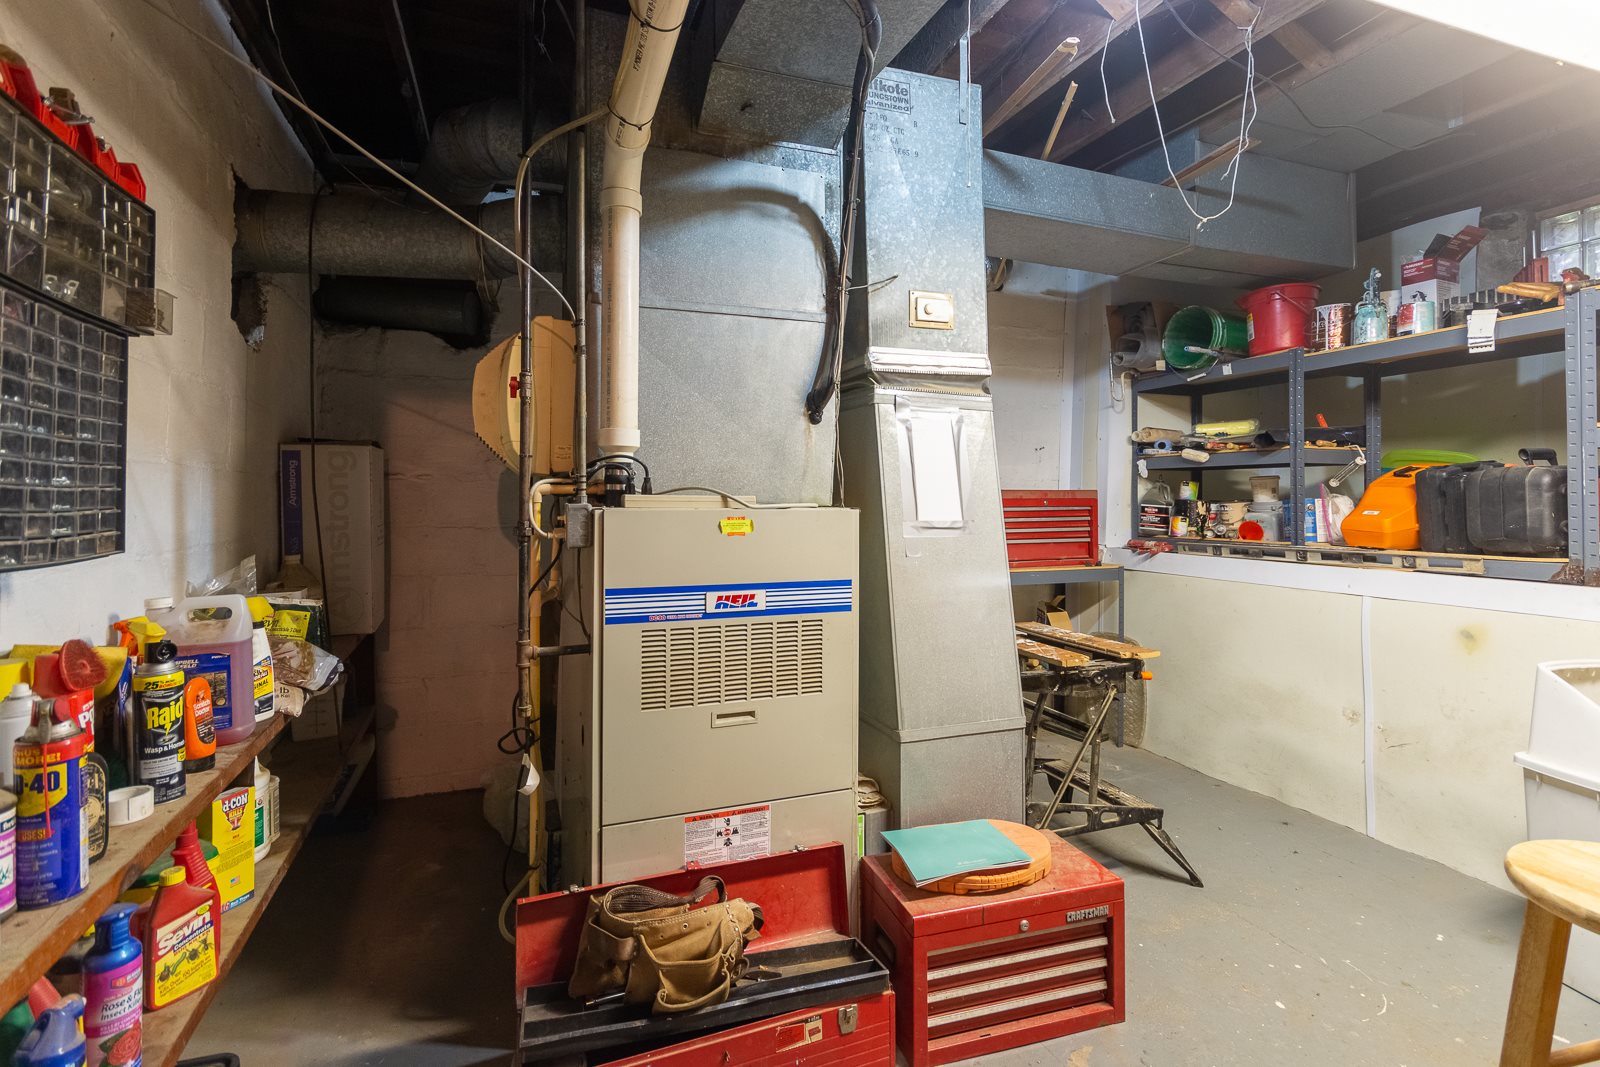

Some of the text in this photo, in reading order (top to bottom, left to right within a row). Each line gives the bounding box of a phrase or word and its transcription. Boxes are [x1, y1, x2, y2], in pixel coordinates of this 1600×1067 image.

[288, 460, 298, 506] Armstrong
[714, 593, 759, 610] HEIL
[147, 696, 184, 730] Raid
[144, 746, 163, 754] Wasp
[223, 793, 249, 812] d-CON
[1066, 905, 1109, 923] CRAFTSMAN
[158, 911, 211, 956] Sevin
[100, 1006, 127, 1021] Insect
[101, 999, 126, 1013] Rose
